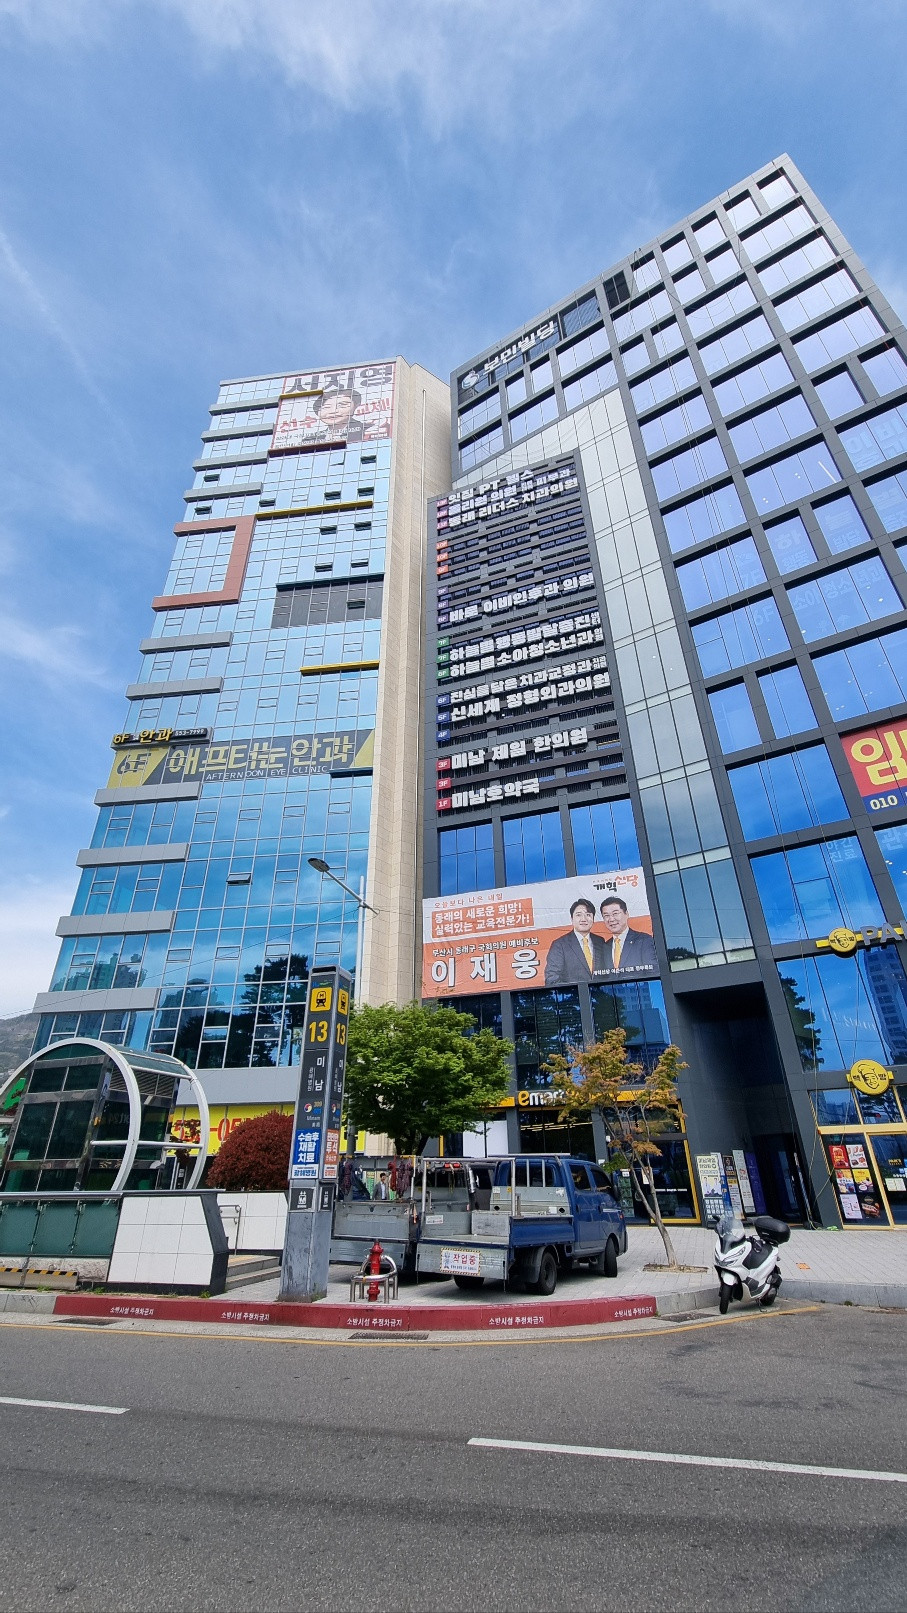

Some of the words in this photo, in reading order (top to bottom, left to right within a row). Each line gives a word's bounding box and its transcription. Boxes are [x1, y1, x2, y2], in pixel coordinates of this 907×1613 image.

[285, 365, 393, 393] 서지영
[479, 480, 500, 495] PT
[479, 497, 520, 518] 리더스
[522, 477, 578, 504] 치과의원
[483, 583, 559, 613] 이비인후과
[562, 572, 595, 591] 의원
[506, 672, 611, 709] 정형외과의원
[140, 727, 173, 743] 안과
[438, 731, 447, 739] 4F
[438, 760, 448, 768] 3F
[451, 749, 486, 770] 미남
[491, 740, 527, 760] 제일
[533, 727, 588, 753] 한의원
[206, 769, 264, 781] AFTERNOON
[270, 768, 286, 776] EYE
[292, 765, 329, 775] CLINIC
[438, 779, 448, 787] 3F
[451, 777, 540, 808] 미남호약국
[870, 795, 898, 810] 010
[434, 899, 465, 909] 오늘보다
[468, 895, 484, 904] 나은
[488, 893, 504, 901] 내일
[435, 910, 463, 924] 동래의
[466, 905, 495, 920] 새로운
[498, 902, 522, 915] 희망!
[435, 921, 473, 936] 실력있는
[475, 913, 530, 930] 교육전문가!
[432, 947, 454, 957] 부산시
[455, 944, 476, 955] 동래구
[478, 940, 507, 951] 국회의원
[508, 937, 539, 949] 예비후보
[309, 1020, 329, 1043] 13
[336, 1022, 346, 1046] 13
[298, 1132, 320, 1142] 수술후
[298, 1142, 316, 1152] 재활
[297, 1152, 315, 1163] 치료
[453, 1253, 477, 1266] 작업중
